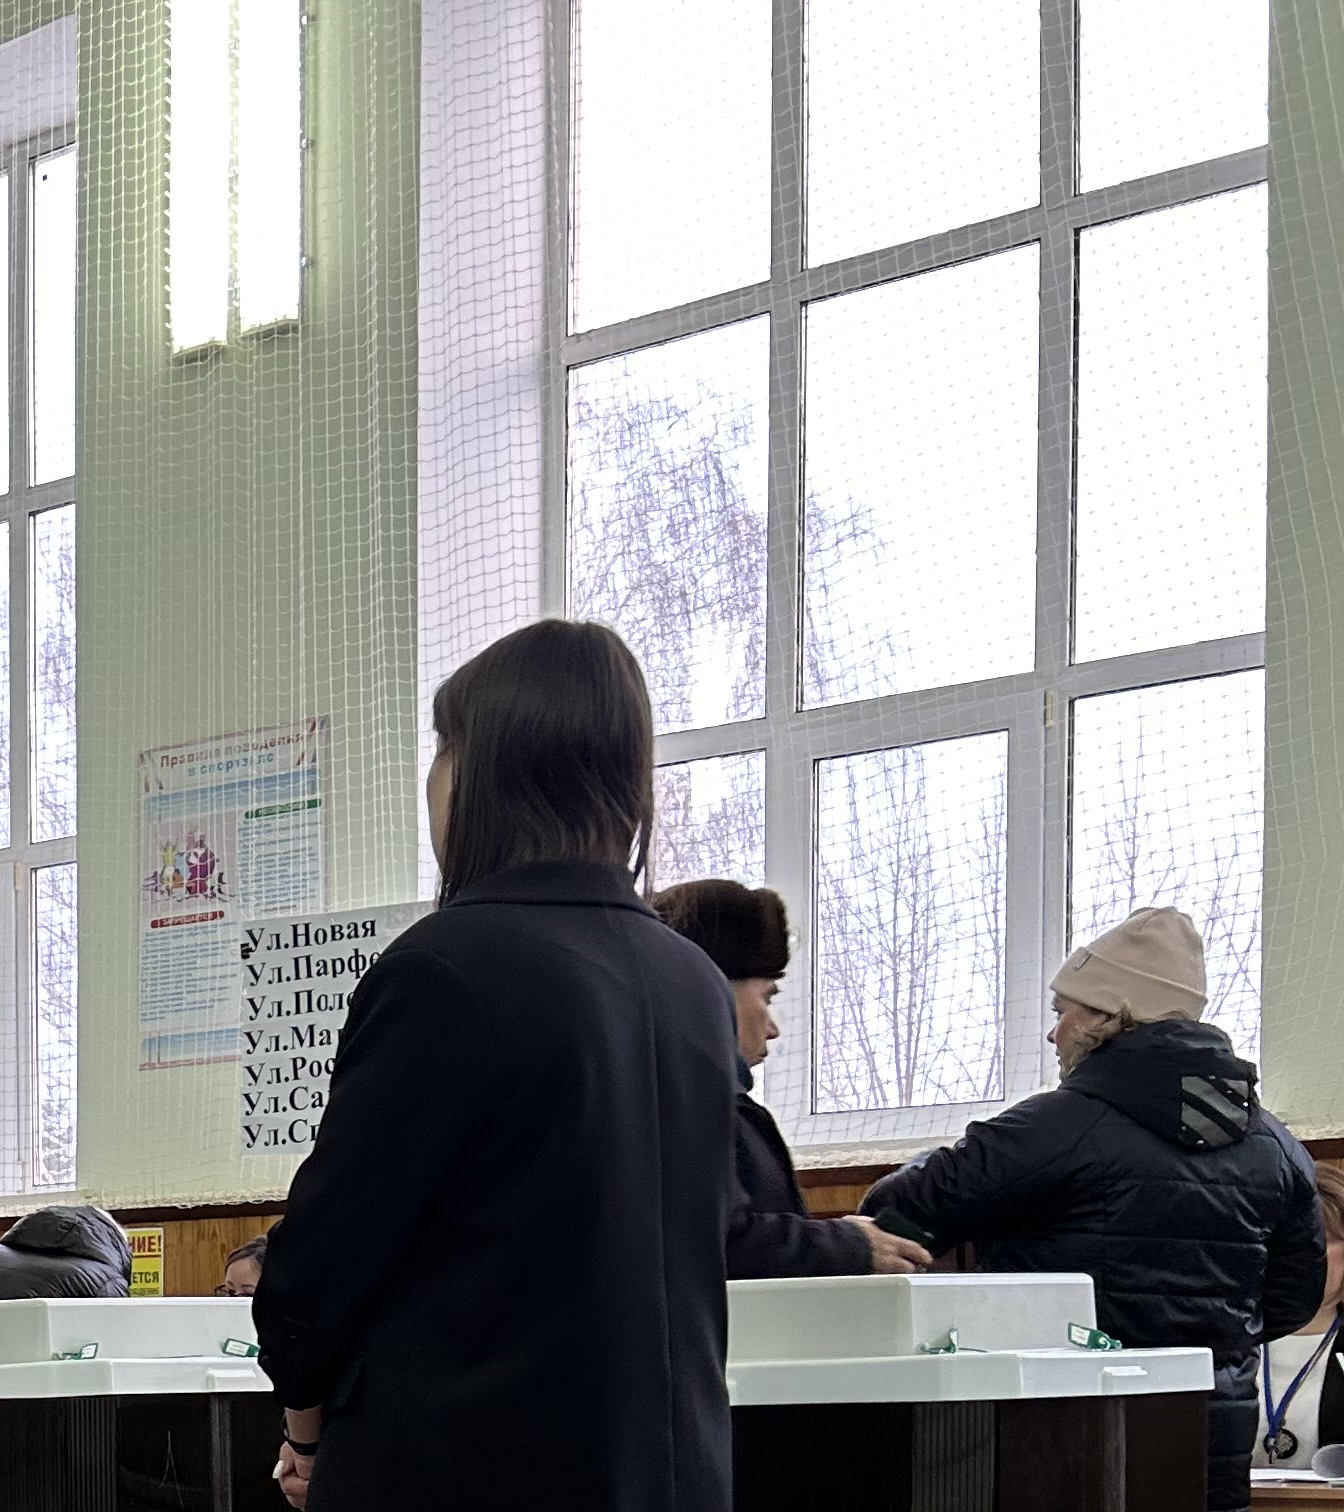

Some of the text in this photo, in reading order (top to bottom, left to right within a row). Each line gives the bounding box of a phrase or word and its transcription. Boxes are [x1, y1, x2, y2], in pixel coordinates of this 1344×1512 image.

[245, 919, 377, 952] Ул.Новая
[243, 1023, 343, 1055] Ул.Ма
[242, 1086, 331, 1116] Ул.Са
